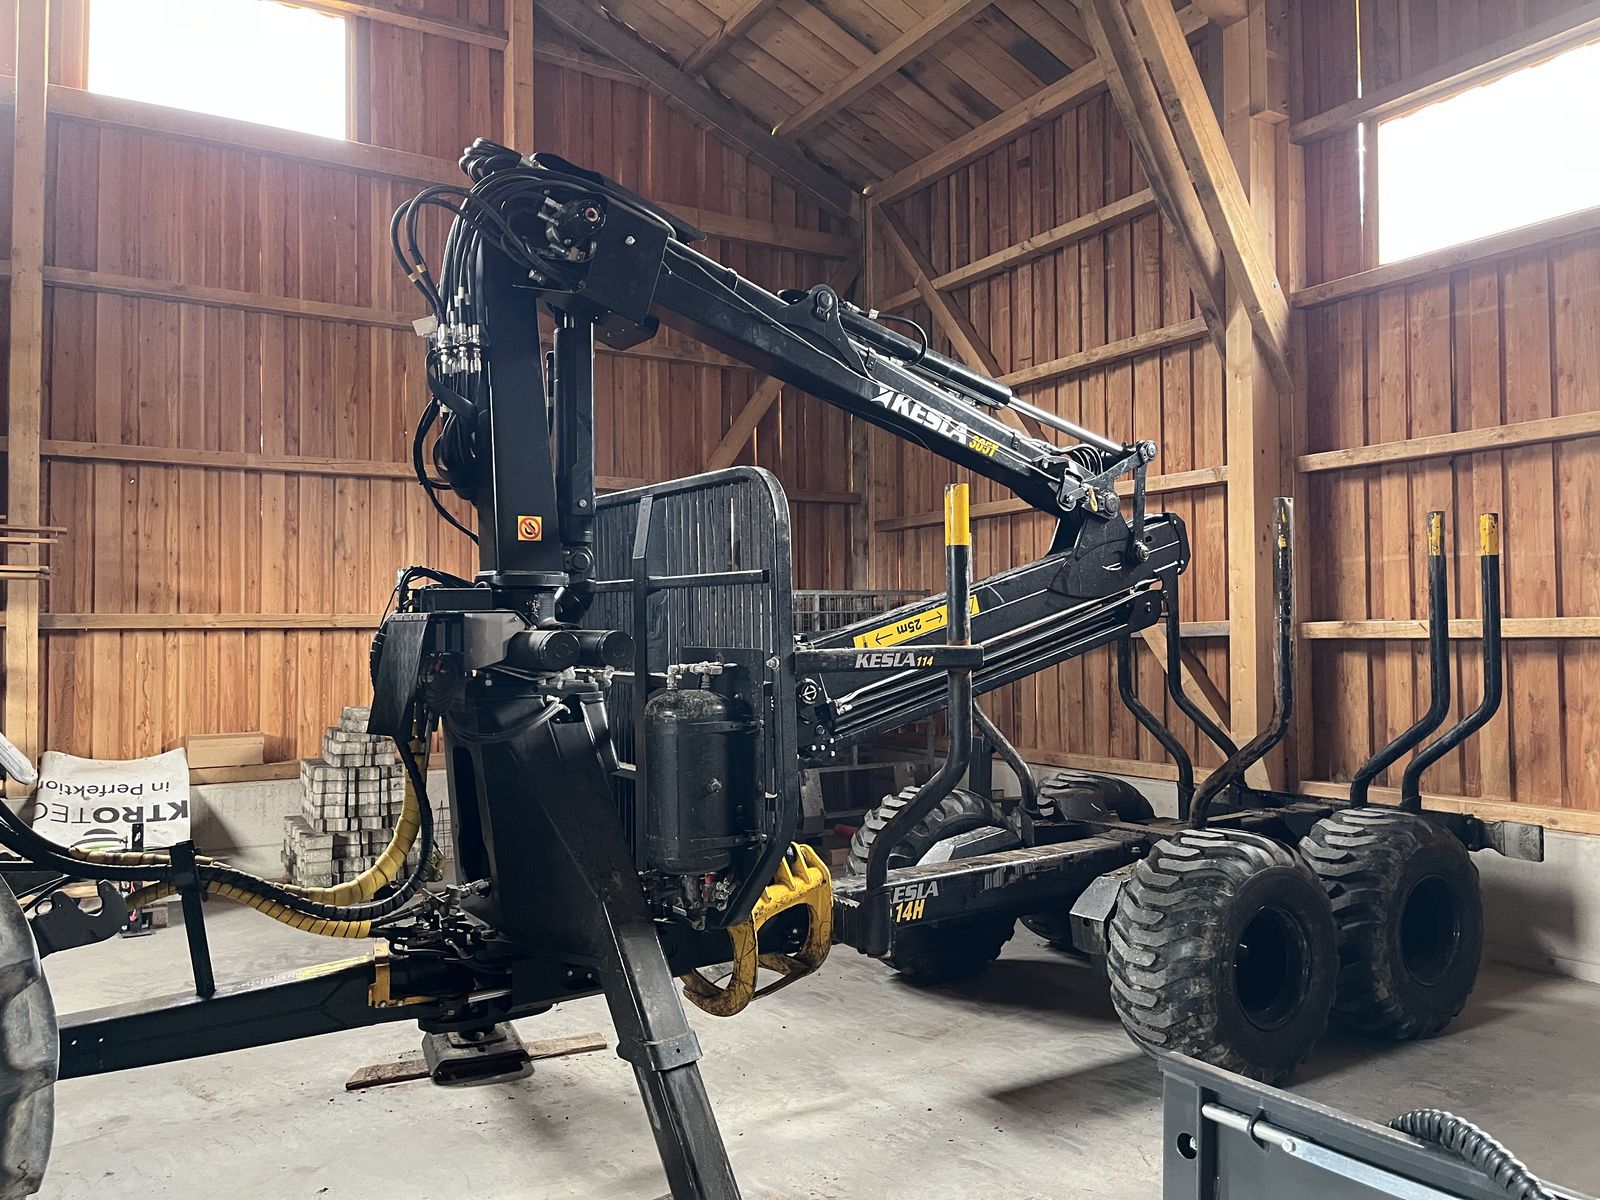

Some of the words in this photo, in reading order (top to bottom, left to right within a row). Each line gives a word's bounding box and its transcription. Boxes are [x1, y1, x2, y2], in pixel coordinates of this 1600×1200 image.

[891, 393, 968, 445] KESLA
[896, 618, 922, 635] 25m
[855, 652, 916, 669] KESLA
[916, 655, 934, 667] 114
[151, 781, 169, 792] in
[890, 880, 939, 904] ESLA
[890, 898, 926, 923] 14H
